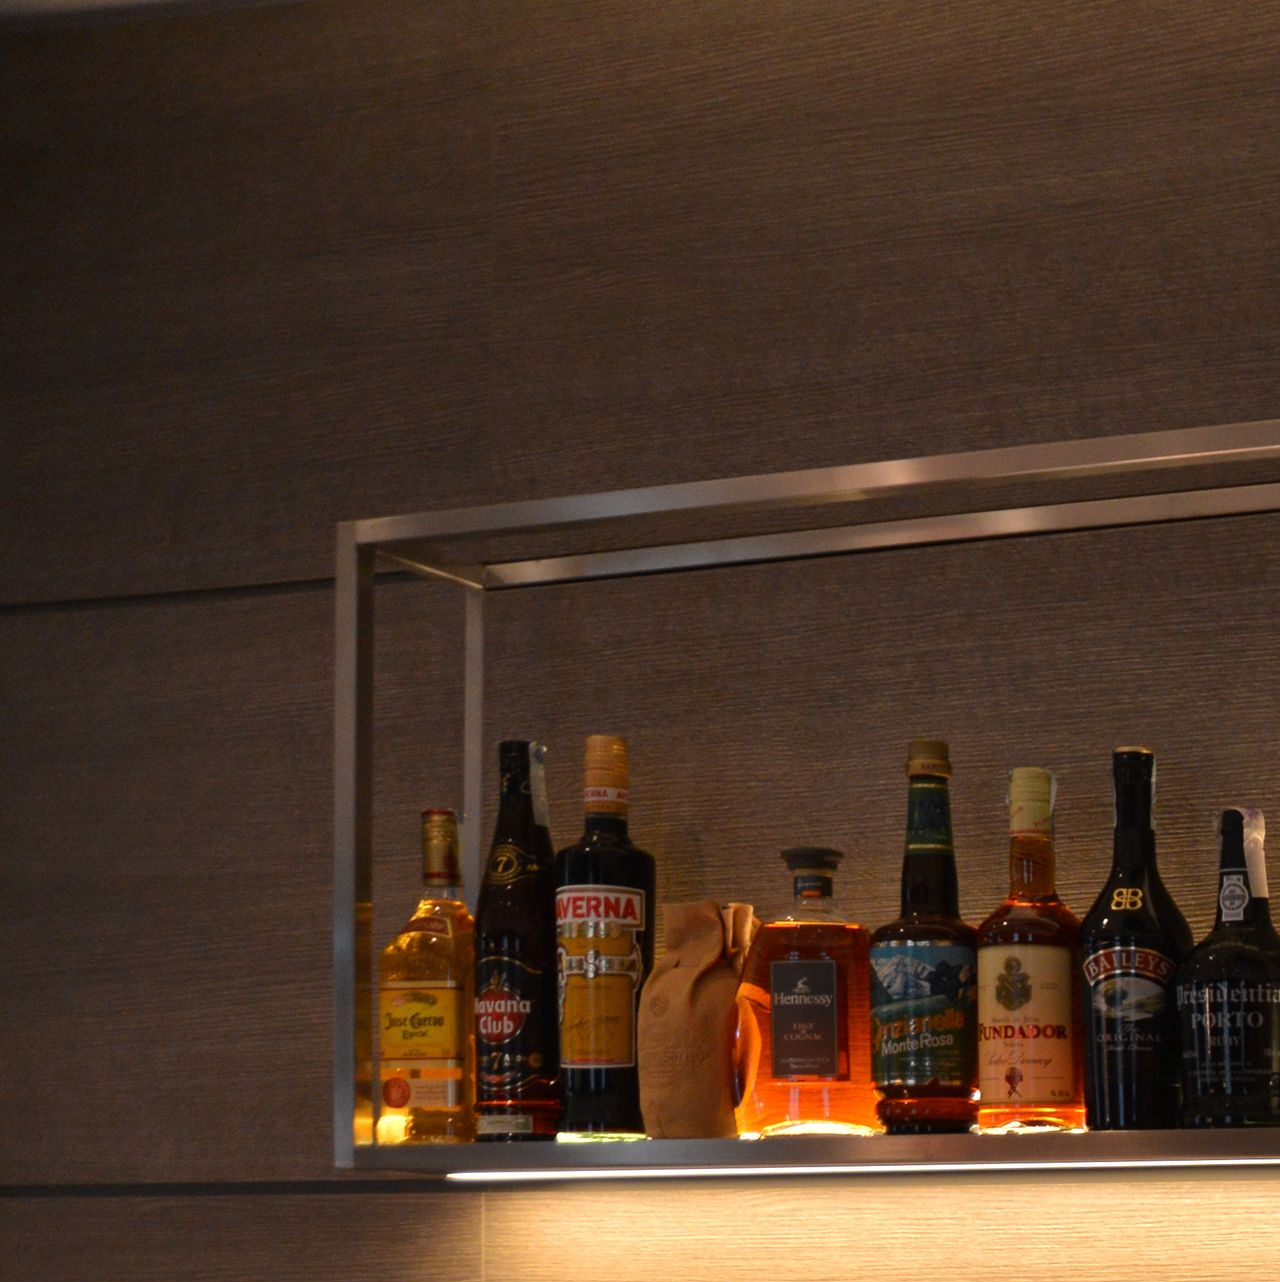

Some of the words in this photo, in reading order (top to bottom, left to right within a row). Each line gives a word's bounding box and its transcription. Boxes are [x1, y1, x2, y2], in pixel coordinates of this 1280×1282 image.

[1088, 953, 1170, 977] BAILEYS
[774, 992, 833, 1007] Hennessy
[409, 1013, 445, 1029] Cuervo
[479, 1015, 514, 1034] Club
[1191, 1011, 1264, 1030] PORTO
[978, 1023, 1068, 1041] FUNDADOR
[1096, 1033, 1162, 1043] ORIGINAL
[882, 1036, 919, 1056] Monte
[919, 1032, 955, 1049] Rosa
